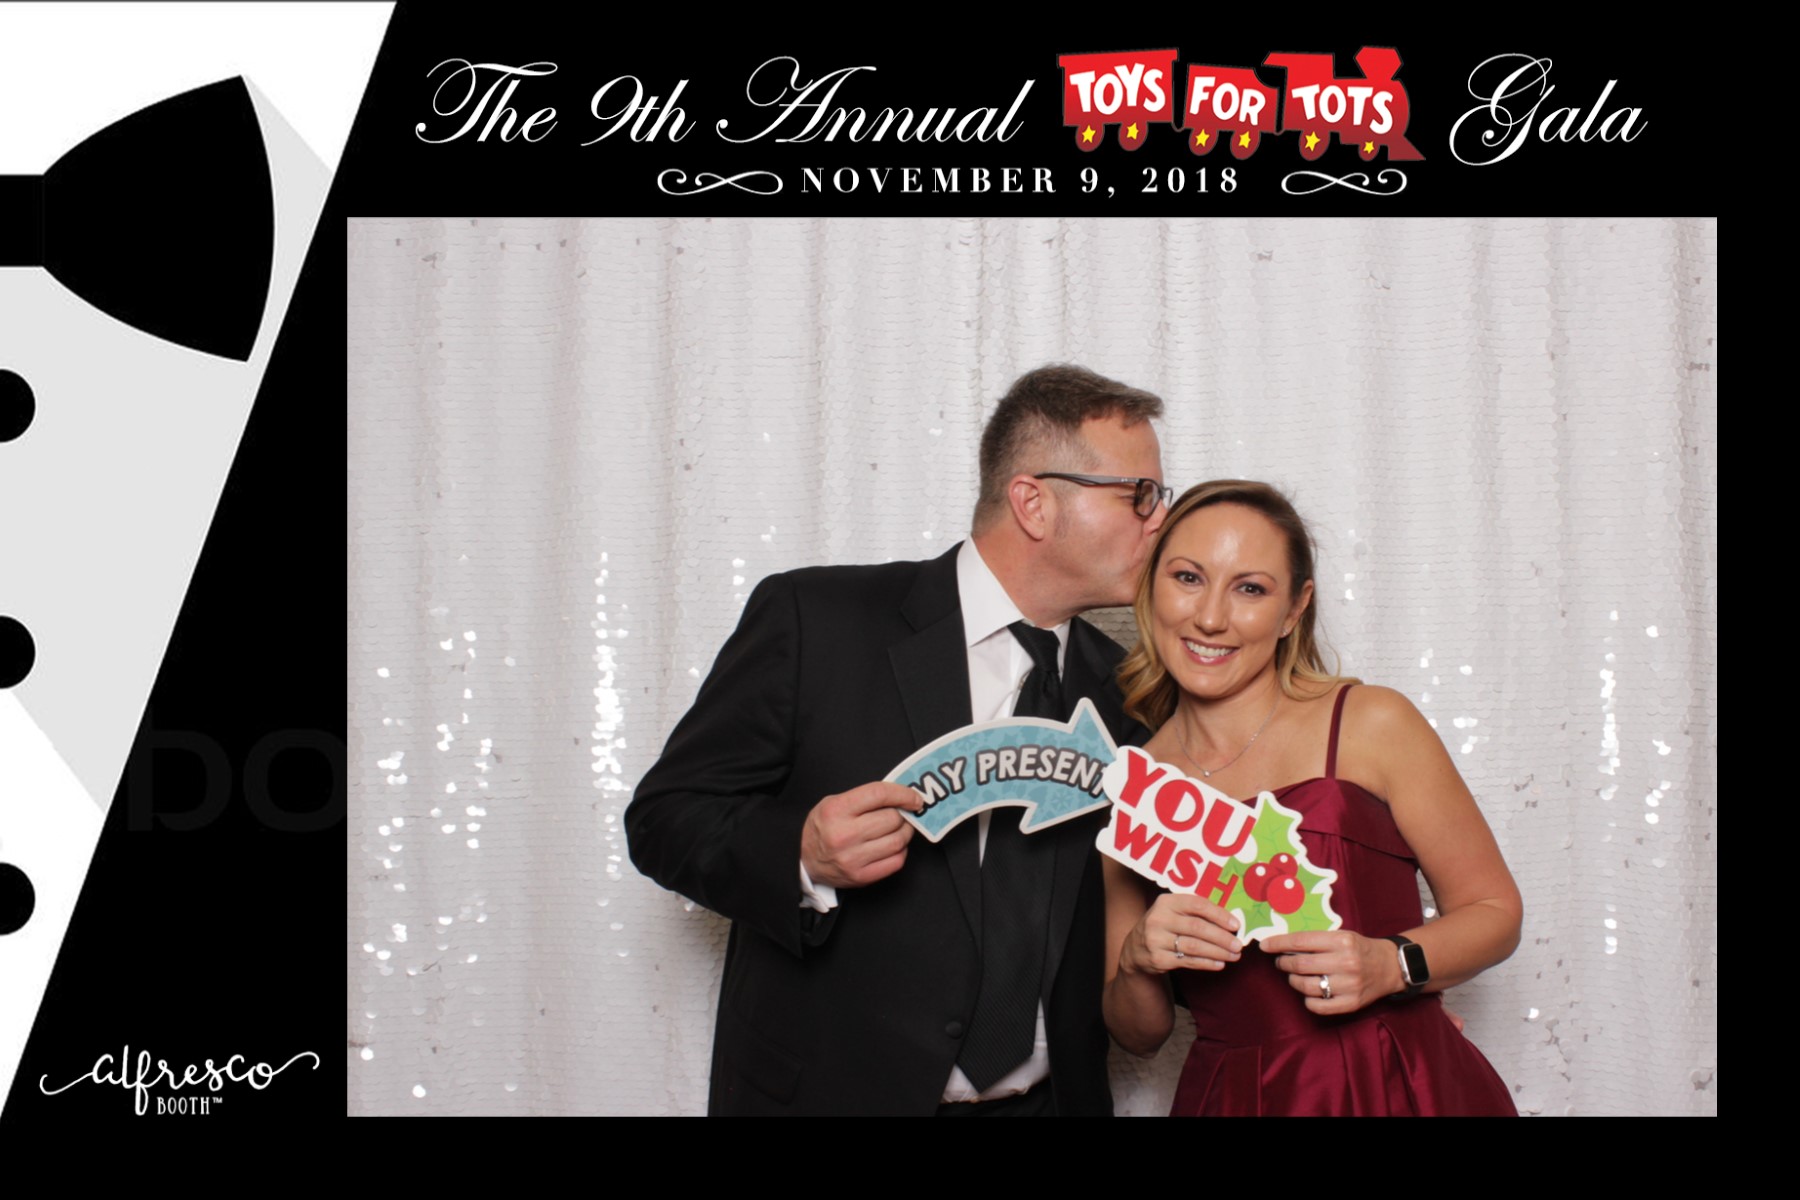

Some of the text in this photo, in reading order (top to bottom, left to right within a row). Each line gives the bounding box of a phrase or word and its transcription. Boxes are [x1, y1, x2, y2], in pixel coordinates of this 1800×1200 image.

[911, 757, 966, 817] MY
[1119, 749, 1257, 857] YOU
[1114, 809, 1240, 907] WISH
